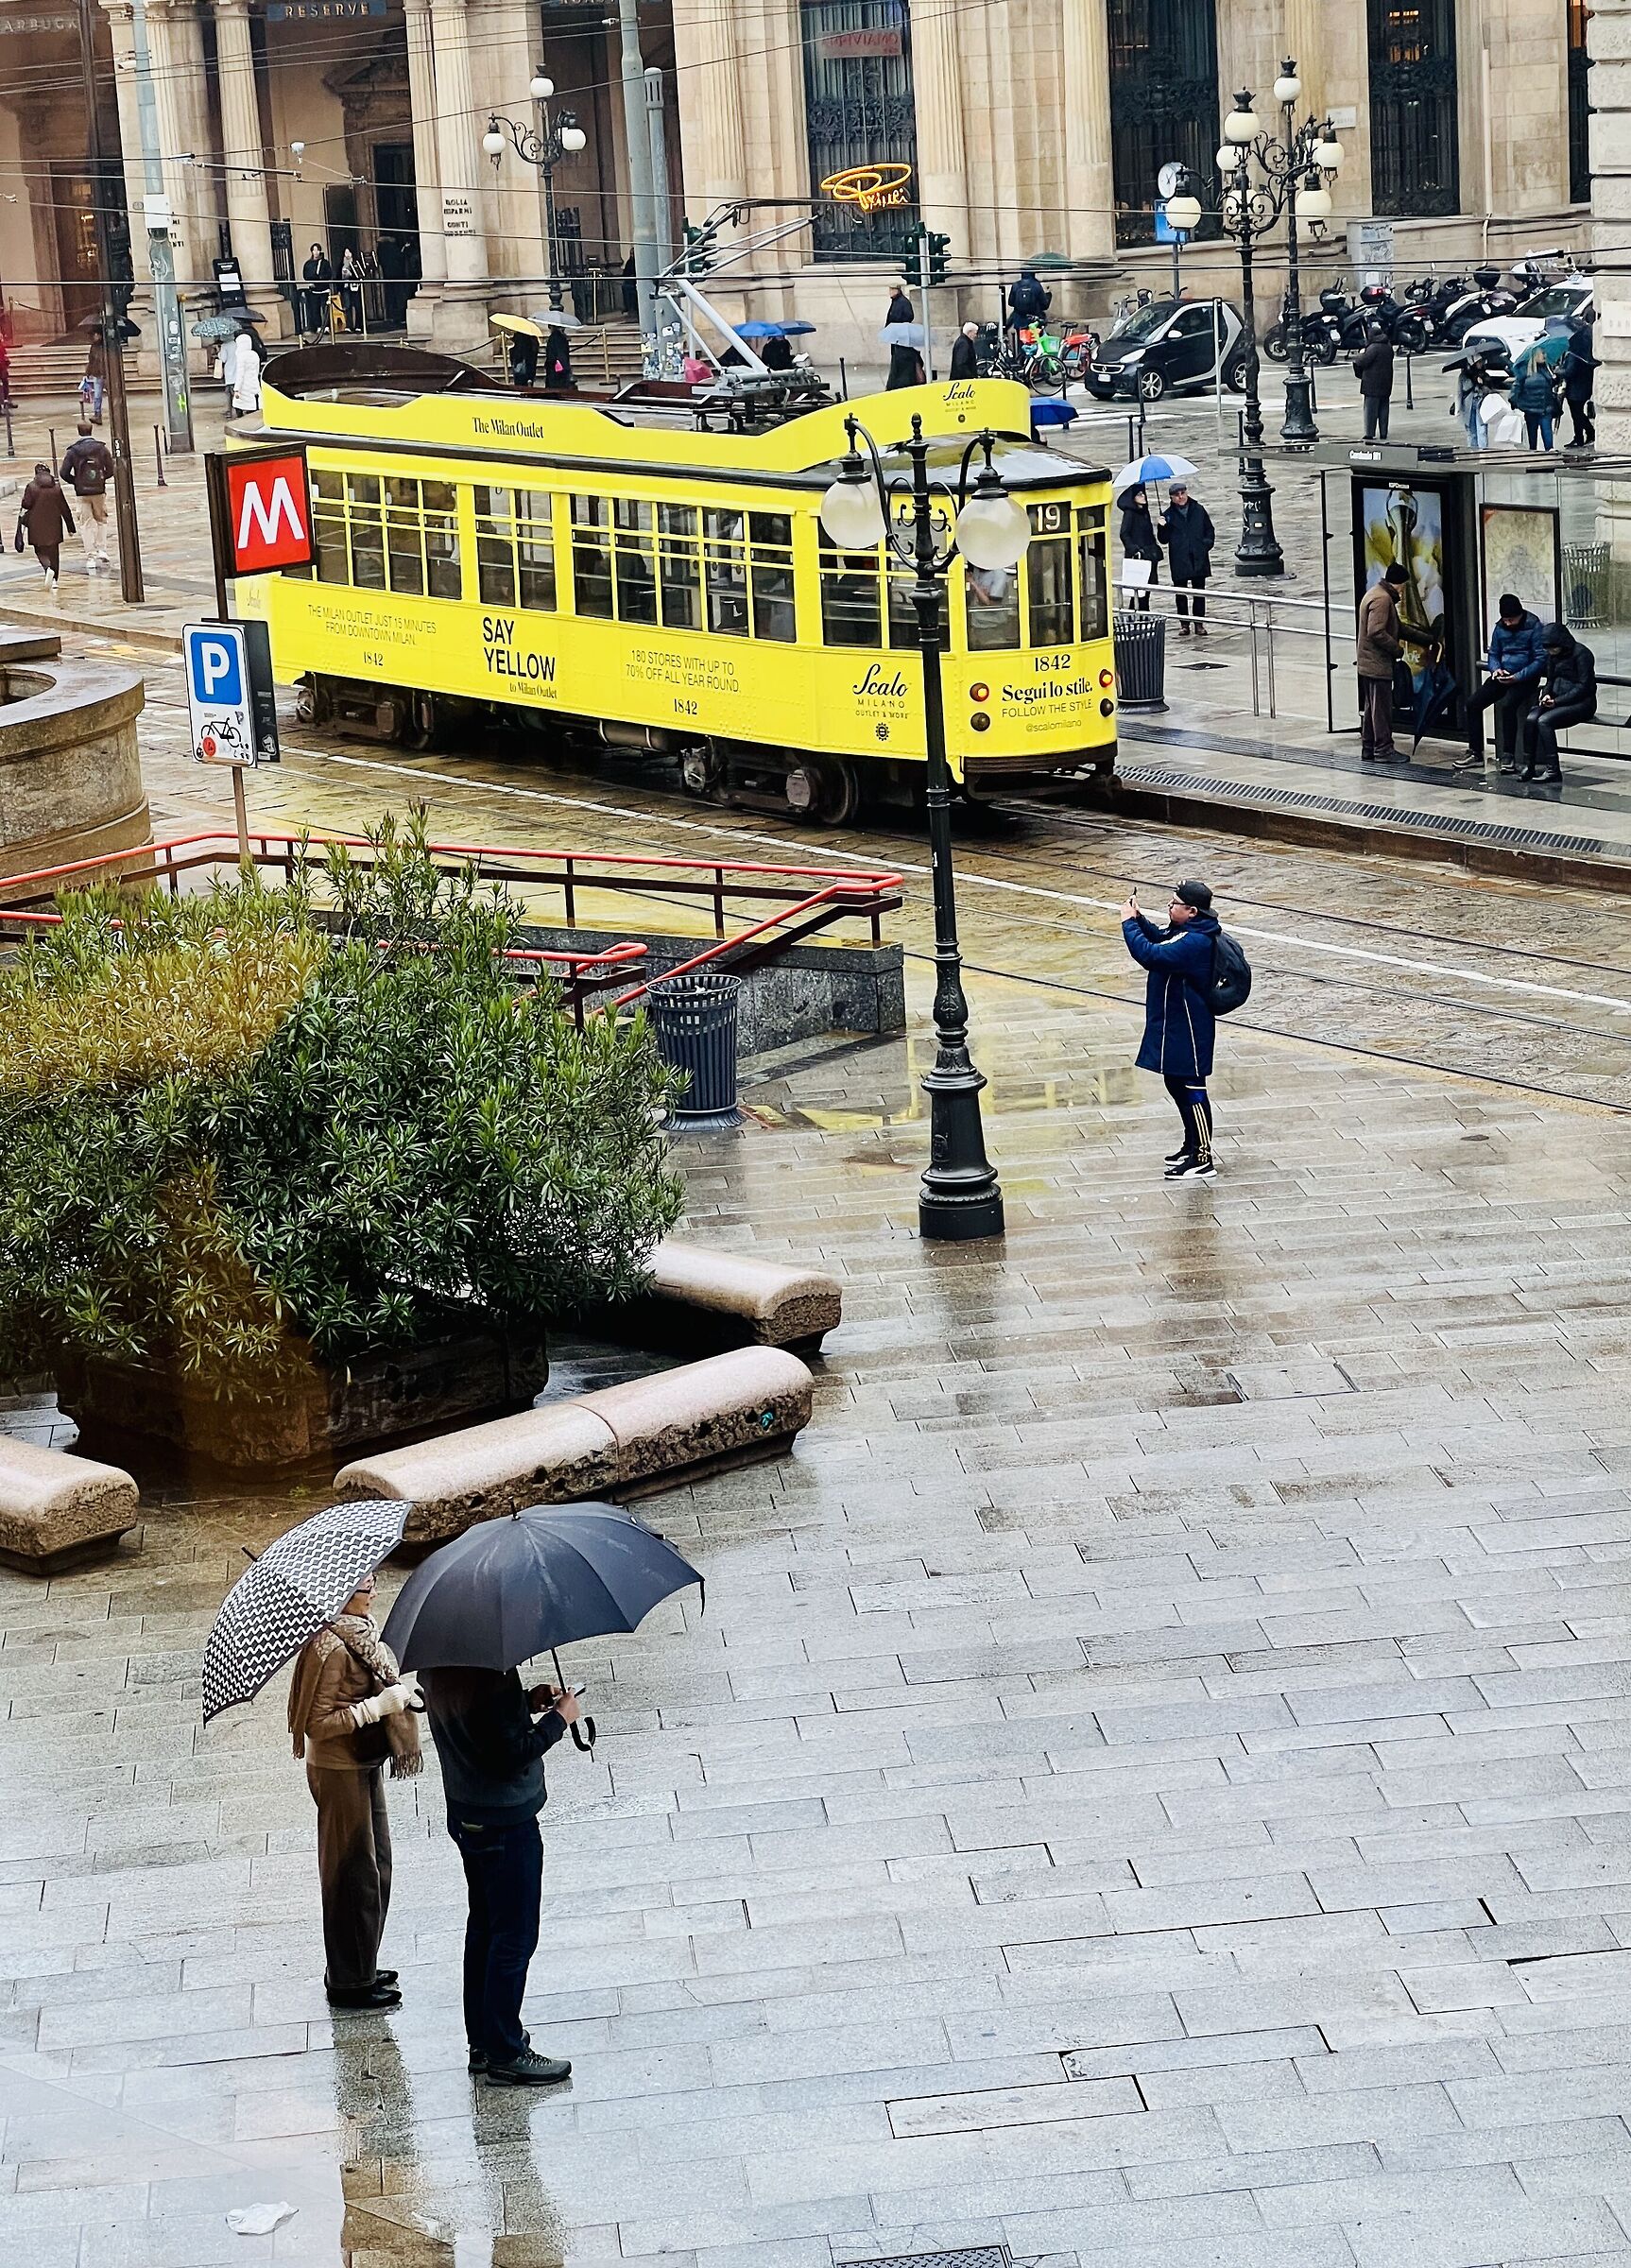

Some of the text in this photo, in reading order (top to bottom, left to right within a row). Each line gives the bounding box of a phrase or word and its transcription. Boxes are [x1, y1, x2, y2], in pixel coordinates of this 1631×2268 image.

[284, 3, 369, 17] RESERVE
[943, 382, 975, 401] Scalo
[472, 417, 544, 438] The Milan Outlet
[238, 476, 305, 549] M
[1038, 504, 1060, 532] 19
[308, 605, 437, 634] THE MILAN OUTLET JUST 15 MINUTES
[326, 622, 346, 634] FROM
[349, 625, 391, 642] DOWNTOWN
[483, 616, 515, 645] SAY
[364, 651, 384, 666] 1842
[484, 647, 555, 681] YELLOW
[631, 650, 734, 676] 180 STORES WITH UP TO
[1035, 654, 1071, 672] 1842
[201, 642, 231, 696] P
[626, 663, 644, 679] 70%
[645, 666, 662, 680] OFF
[664, 670, 680, 684] ALL
[681, 672, 705, 688] YEAR
[852, 663, 908, 696] Scalo
[509, 681, 558, 699] to Milan Outlet
[1002, 677, 1093, 705] Segui lo stile.
[674, 697, 697, 715] 1842
[857, 698, 905, 709] MILANO
[1002, 705, 1046, 718] FOLLOW
[1049, 702, 1067, 713] THE
[888, 711, 908, 719] MORE
[1025, 719, 1082, 733] @scalomilano
